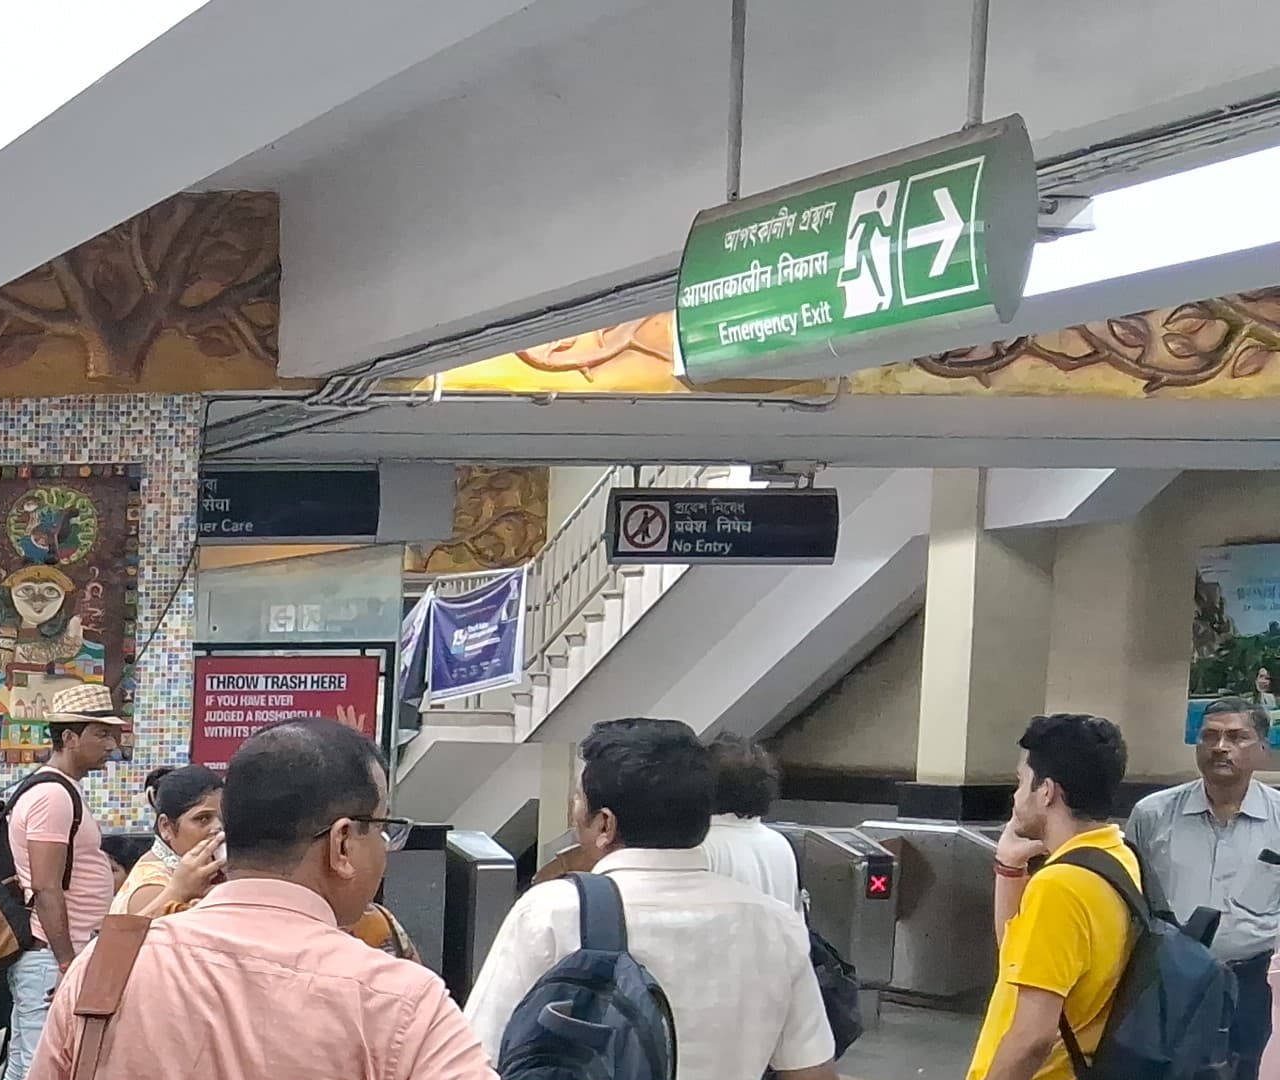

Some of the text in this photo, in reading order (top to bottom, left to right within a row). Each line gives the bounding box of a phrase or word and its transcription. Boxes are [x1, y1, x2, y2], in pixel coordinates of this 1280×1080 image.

[799, 202, 837, 234] প্রস্থান
[682, 251, 829, 307] आपातकालीन निकास
[718, 301, 833, 346] Emergency Exit
[202, 494, 230, 512] सेवा
[221, 518, 254, 533] Care
[672, 539, 732, 555] No Entry
[208, 675, 345, 690] THROW TRASH HERE
[206, 694, 293, 706] IF YOU HAVE EVER
[204, 711, 244, 722] JUDGED
[245, 711, 253, 722] A
[204, 726, 231, 738] WITH
[233, 726, 249, 738] ITS
